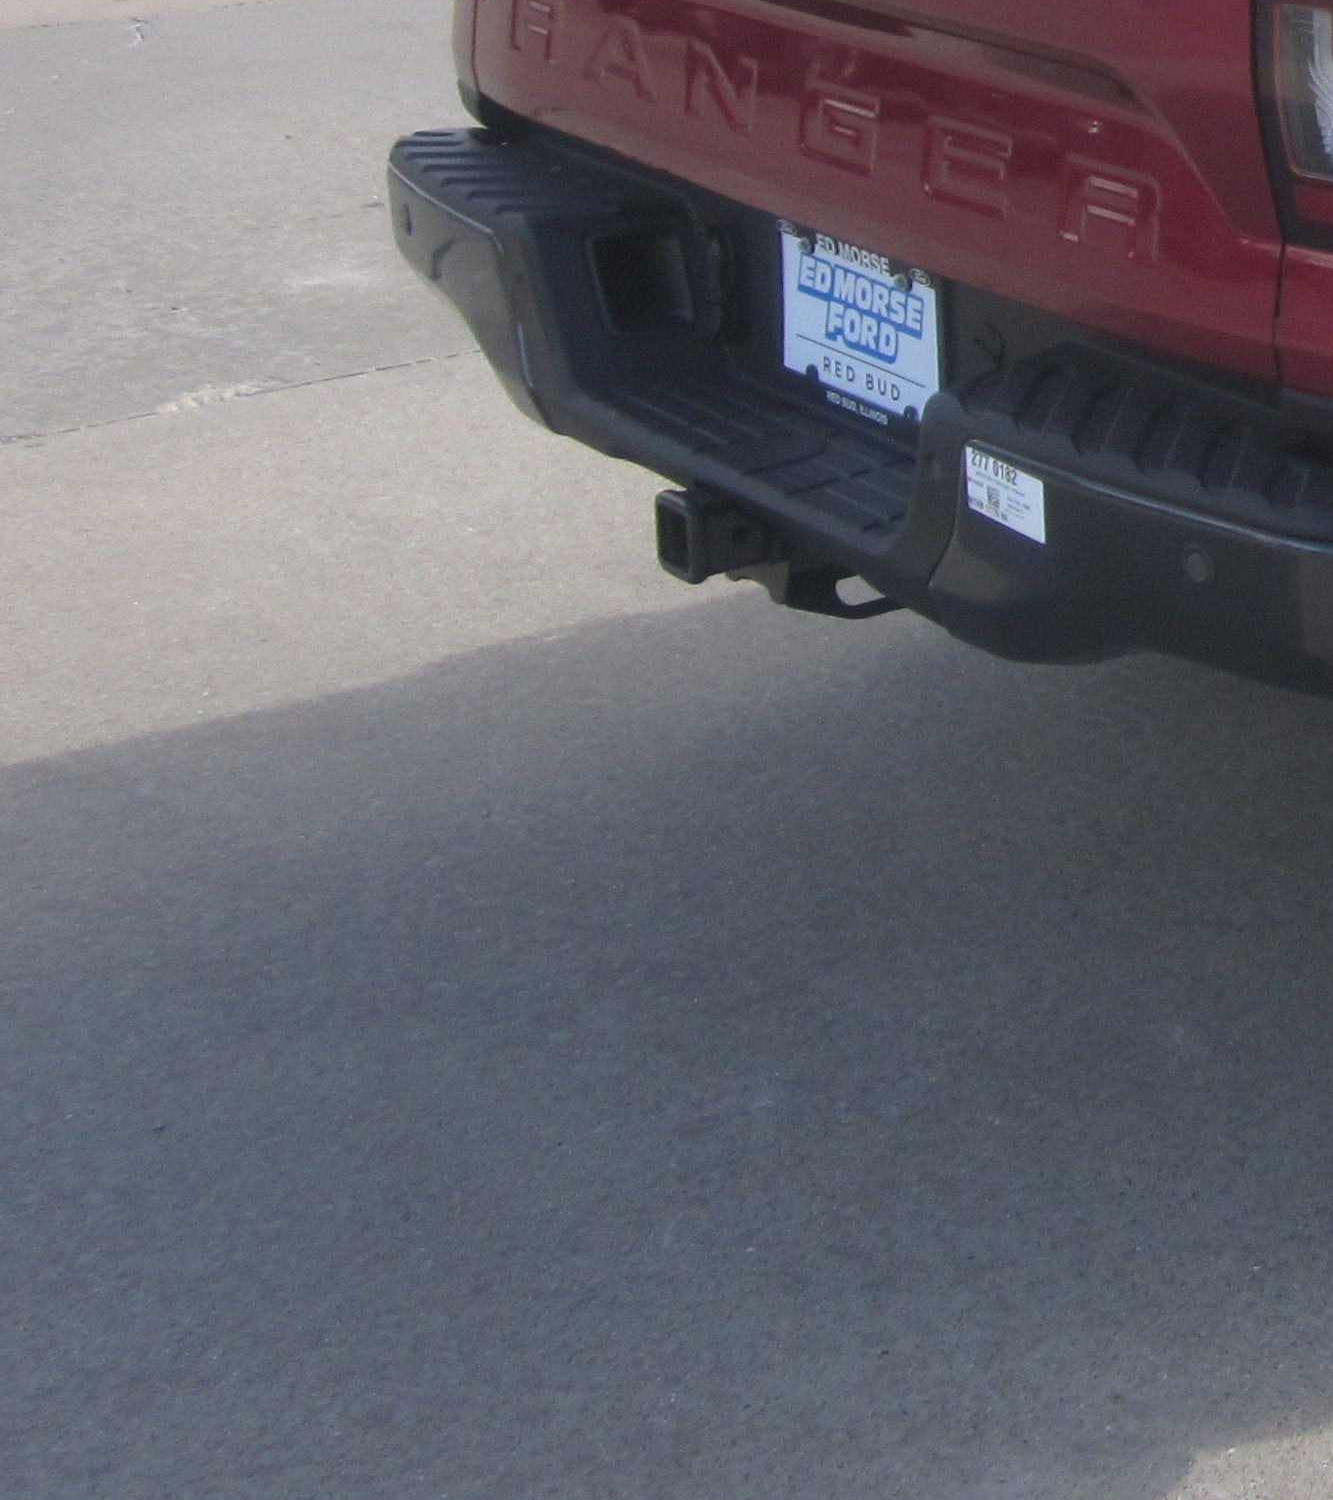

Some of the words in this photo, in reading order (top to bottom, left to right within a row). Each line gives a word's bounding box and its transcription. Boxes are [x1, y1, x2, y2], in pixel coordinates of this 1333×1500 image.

[815, 233, 836, 254] ED
[838, 241, 892, 275] MORSE
[800, 254, 832, 294] ED
[833, 266, 923, 334] MORSE
[826, 302, 898, 360] FORD
[821, 355, 856, 383] RED
[865, 373, 901, 401] BUD
